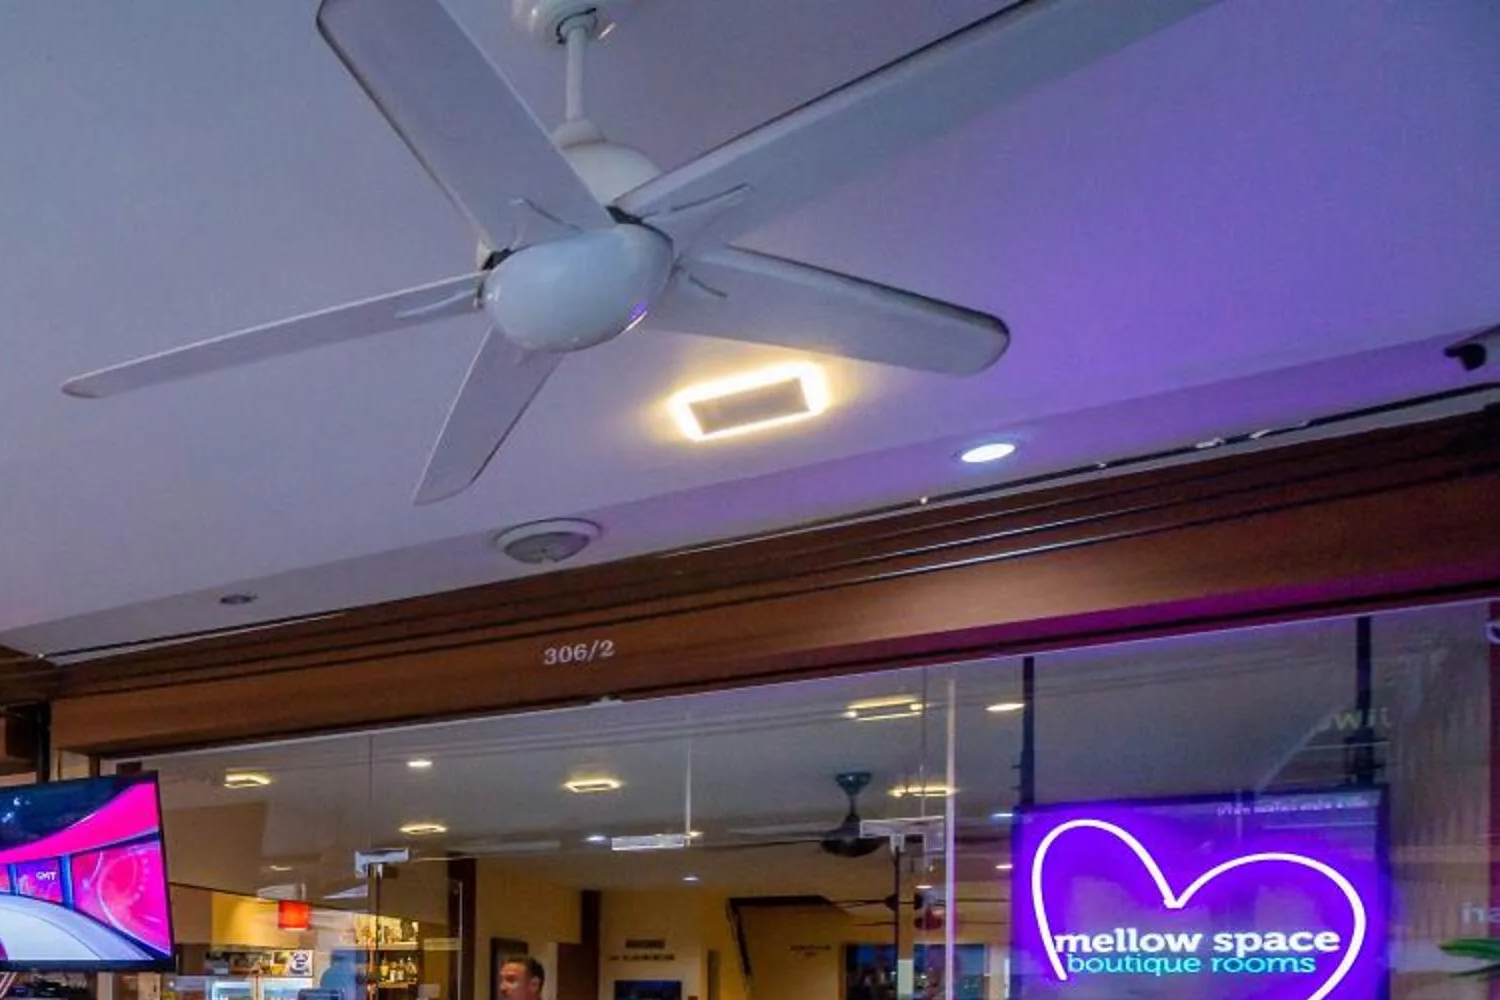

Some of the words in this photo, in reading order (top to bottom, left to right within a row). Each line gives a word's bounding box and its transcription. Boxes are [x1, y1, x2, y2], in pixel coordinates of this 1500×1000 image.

[543, 639, 615, 665] 306/2
[1054, 927, 1203, 953] mellow
[1213, 930, 1341, 958] space
[1066, 953, 1201, 976] boutique
[1211, 956, 1316, 974] rooms
